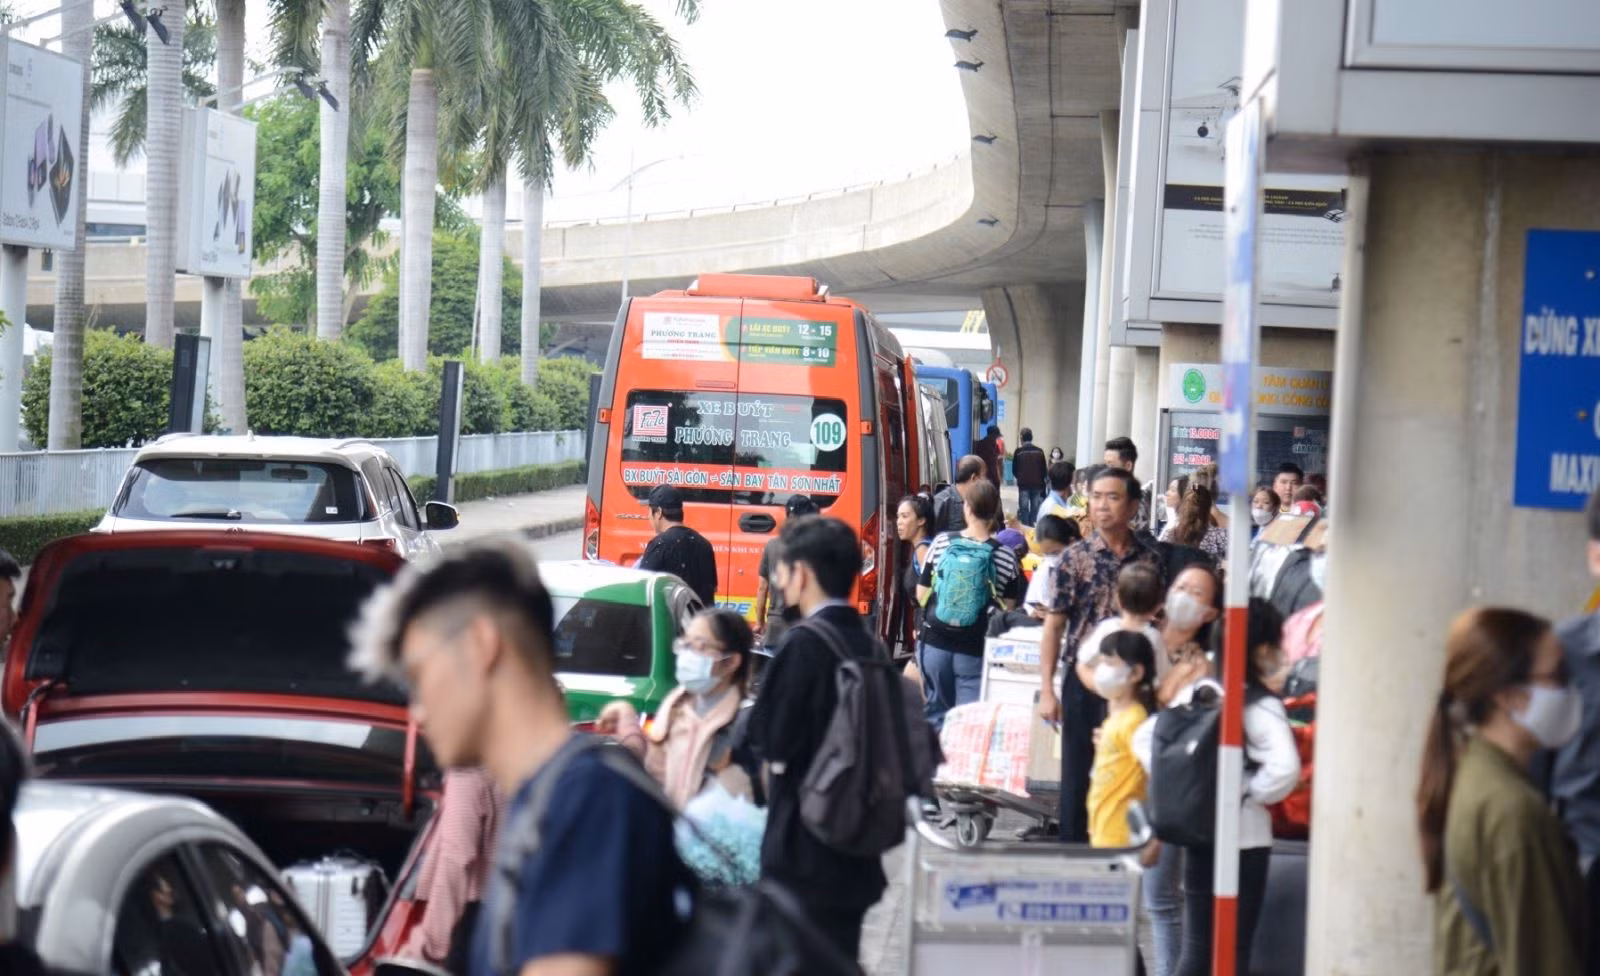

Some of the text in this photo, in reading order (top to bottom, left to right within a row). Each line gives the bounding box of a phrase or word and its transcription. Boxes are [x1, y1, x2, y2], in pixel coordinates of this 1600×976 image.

[687, 331, 717, 339] TRANG
[798, 324, 810, 335] 12
[819, 325, 832, 336] 15
[802, 346, 810, 357] 8
[817, 348, 830, 358] 10
[696, 399, 775, 418] XE BUÝT
[674, 425, 792, 448] PHƯƠNG TRANG
[814, 421, 842, 444] 109
[624, 466, 842, 493] BX BUÝT SÀI GÒN SÂN BAY TÂN SƠN NHẤT
